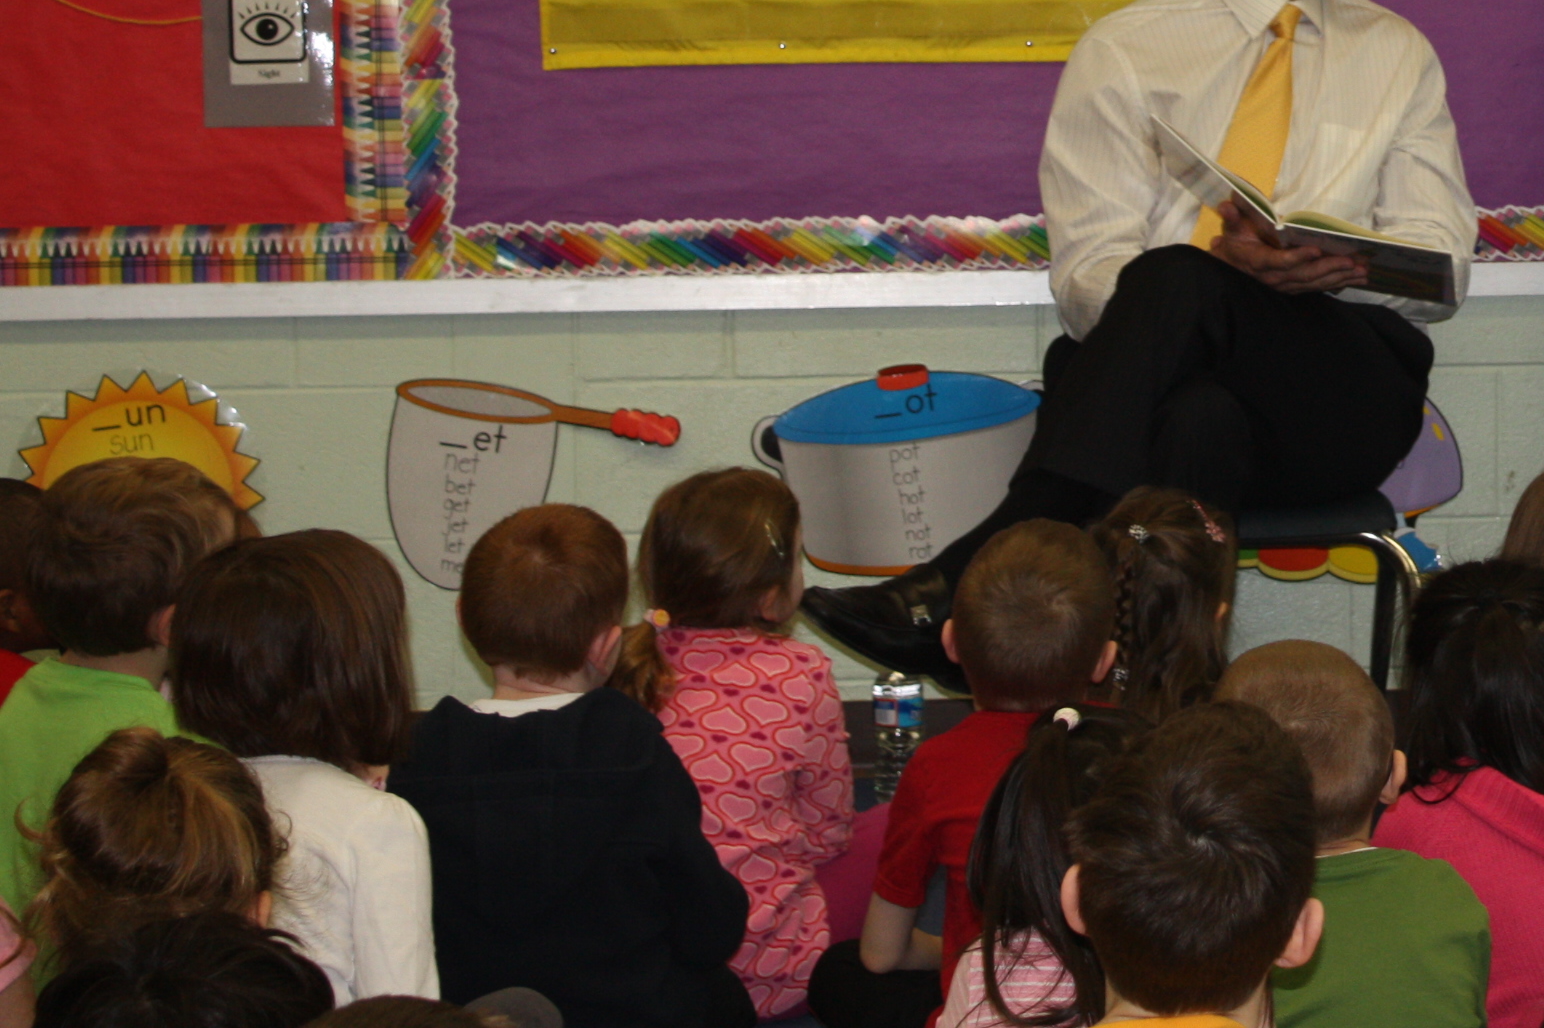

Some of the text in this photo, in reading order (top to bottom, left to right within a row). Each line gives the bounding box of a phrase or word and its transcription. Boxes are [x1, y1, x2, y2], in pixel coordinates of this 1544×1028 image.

[110, 433, 154, 455] sun
[444, 453, 480, 473] net
[889, 442, 920, 471] pot
[444, 474, 476, 494] bet
[892, 466, 920, 485] cot
[898, 486, 925, 505] hot
[902, 507, 924, 524] lot
[905, 526, 931, 541] not
[908, 543, 933, 560] rot
